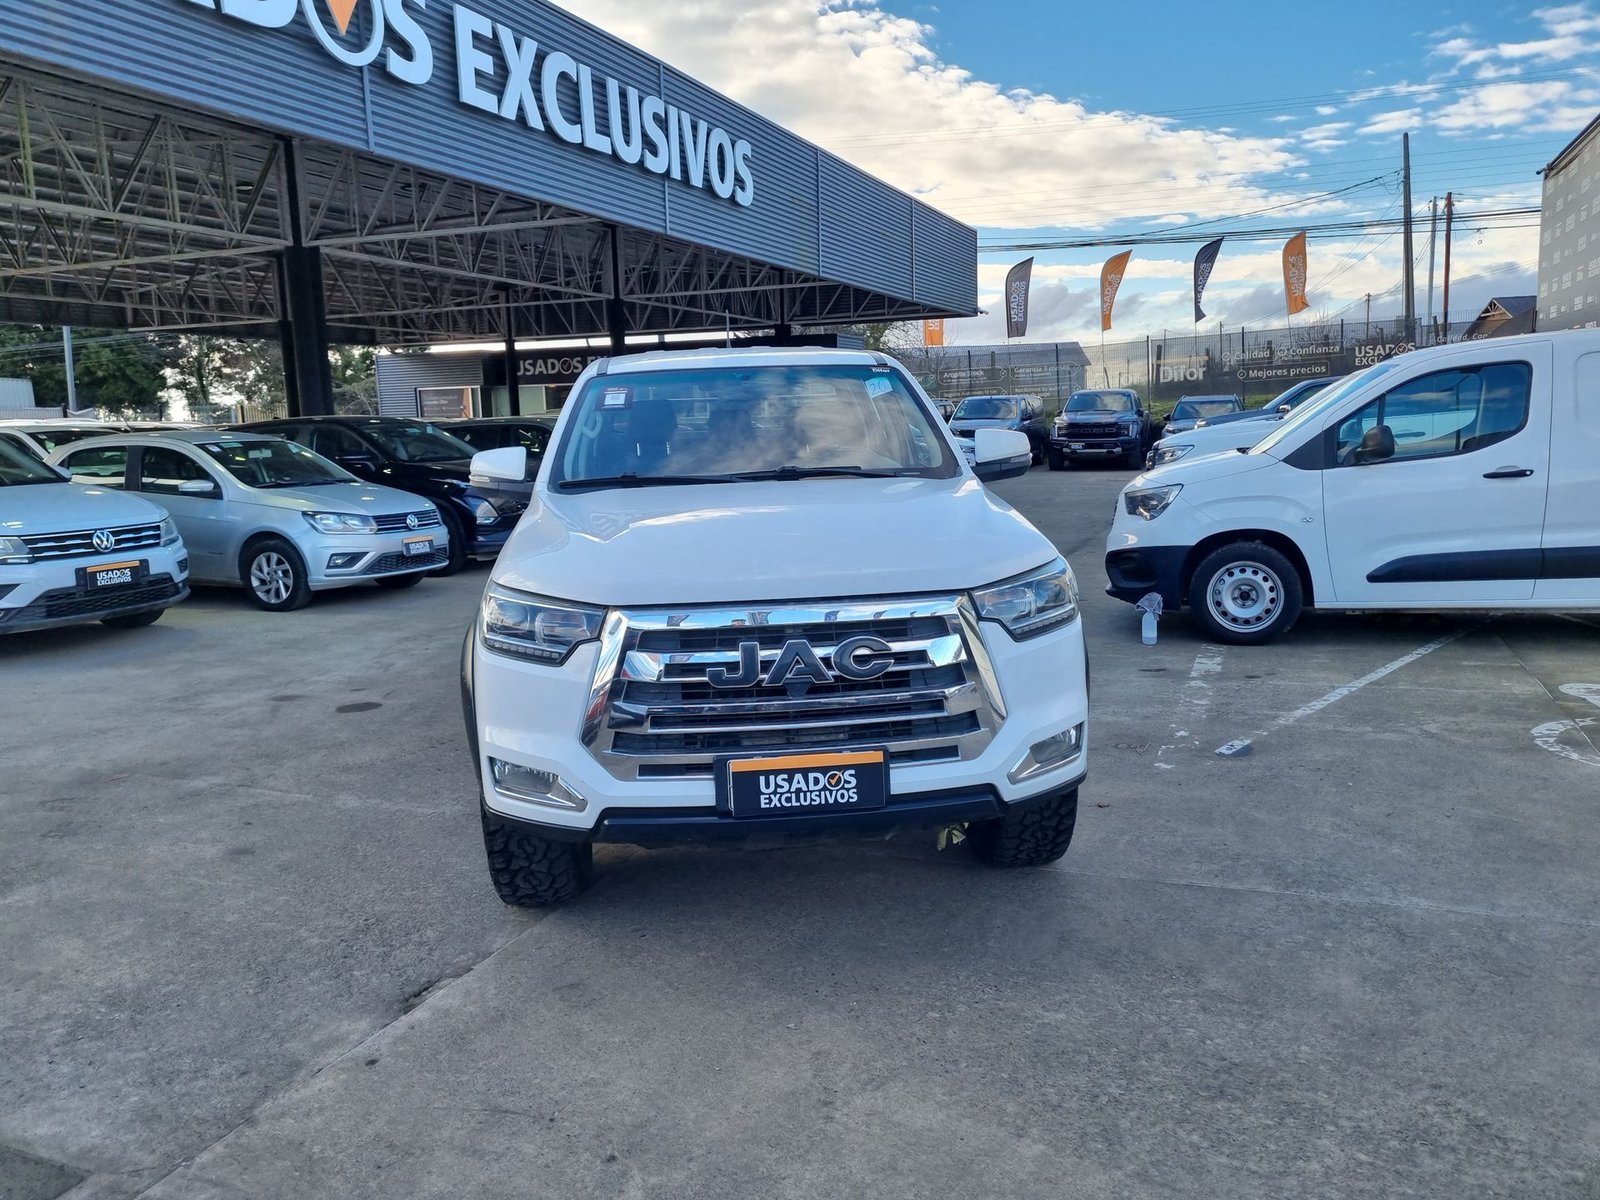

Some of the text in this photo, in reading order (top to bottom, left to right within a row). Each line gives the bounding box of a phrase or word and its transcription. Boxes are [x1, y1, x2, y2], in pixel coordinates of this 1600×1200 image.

[453, 3, 754, 207] EXCLUSIVOS
[1011, 281, 1020, 322] USADOS
[1018, 281, 1026, 322] EXCLUSIVOS
[1234, 344, 1340, 360] Calidad Confianza
[1355, 342, 1416, 359] USADOS
[1160, 365, 1206, 383] Difor
[1249, 364, 1326, 379] Mejores precios
[96, 568, 131, 580] USADOS
[97, 576, 132, 586] EXCLUSIVOS
[706, 635, 895, 689] JAC
[759, 769, 857, 794] USADOS
[760, 788, 858, 808] EXCLUSIVOS
